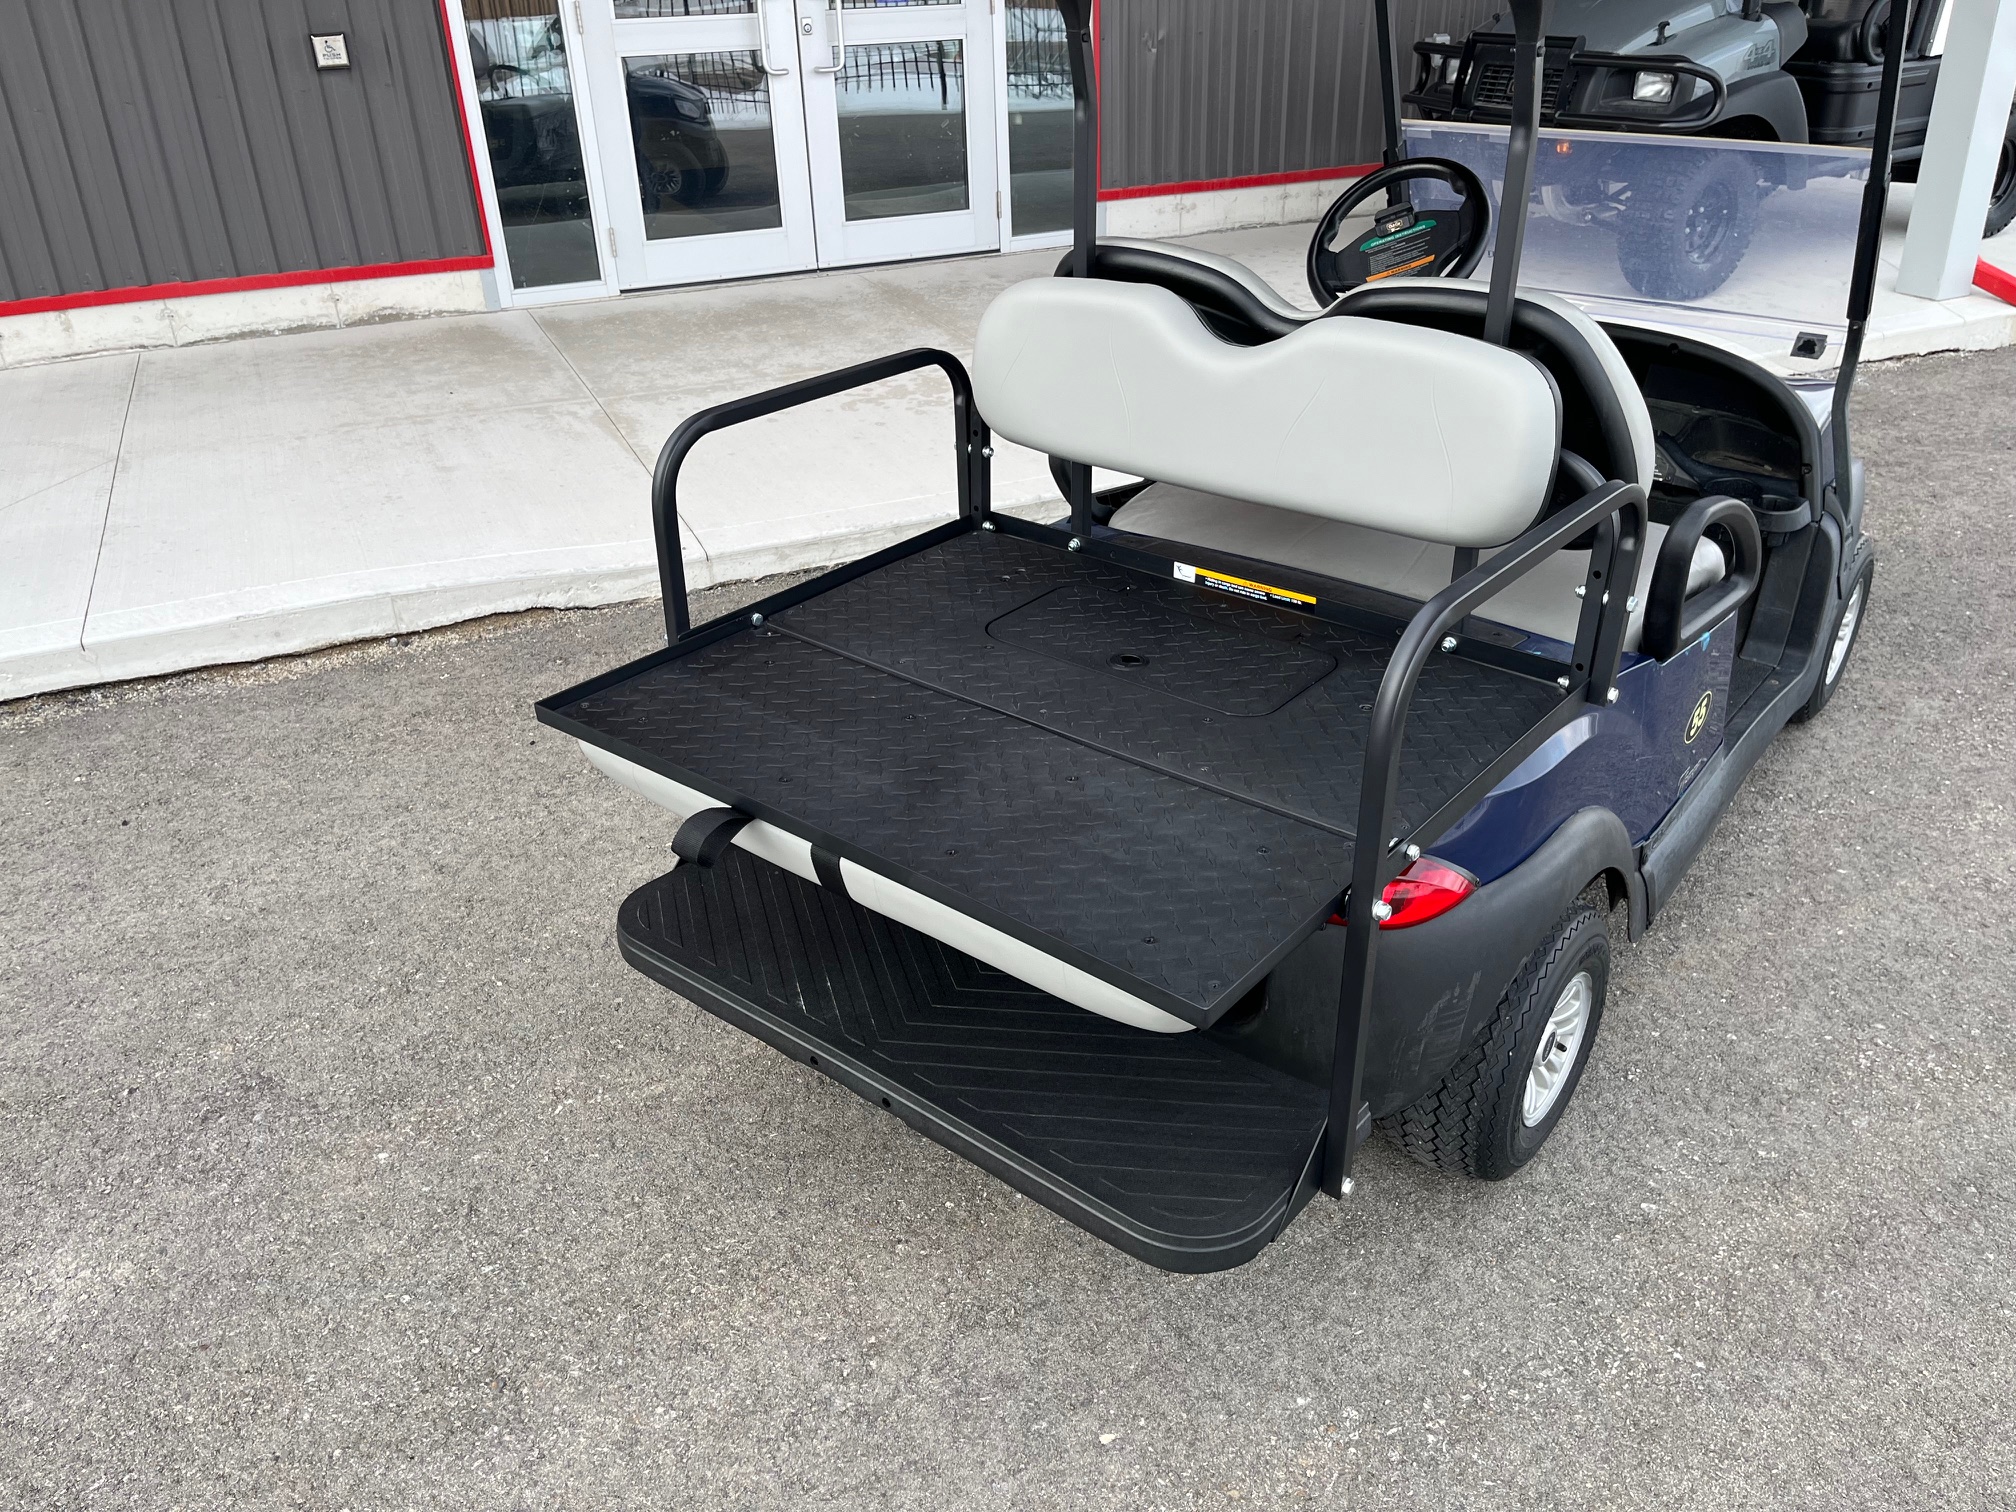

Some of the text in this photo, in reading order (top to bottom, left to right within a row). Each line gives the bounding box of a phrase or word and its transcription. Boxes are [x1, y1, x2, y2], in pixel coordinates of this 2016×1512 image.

[1743, 38, 1776, 62] 4x4
[1370, 236, 1395, 247] OPERATING
[1248, 582, 1273, 593] WARNING
[1689, 696, 1708, 737] 55
